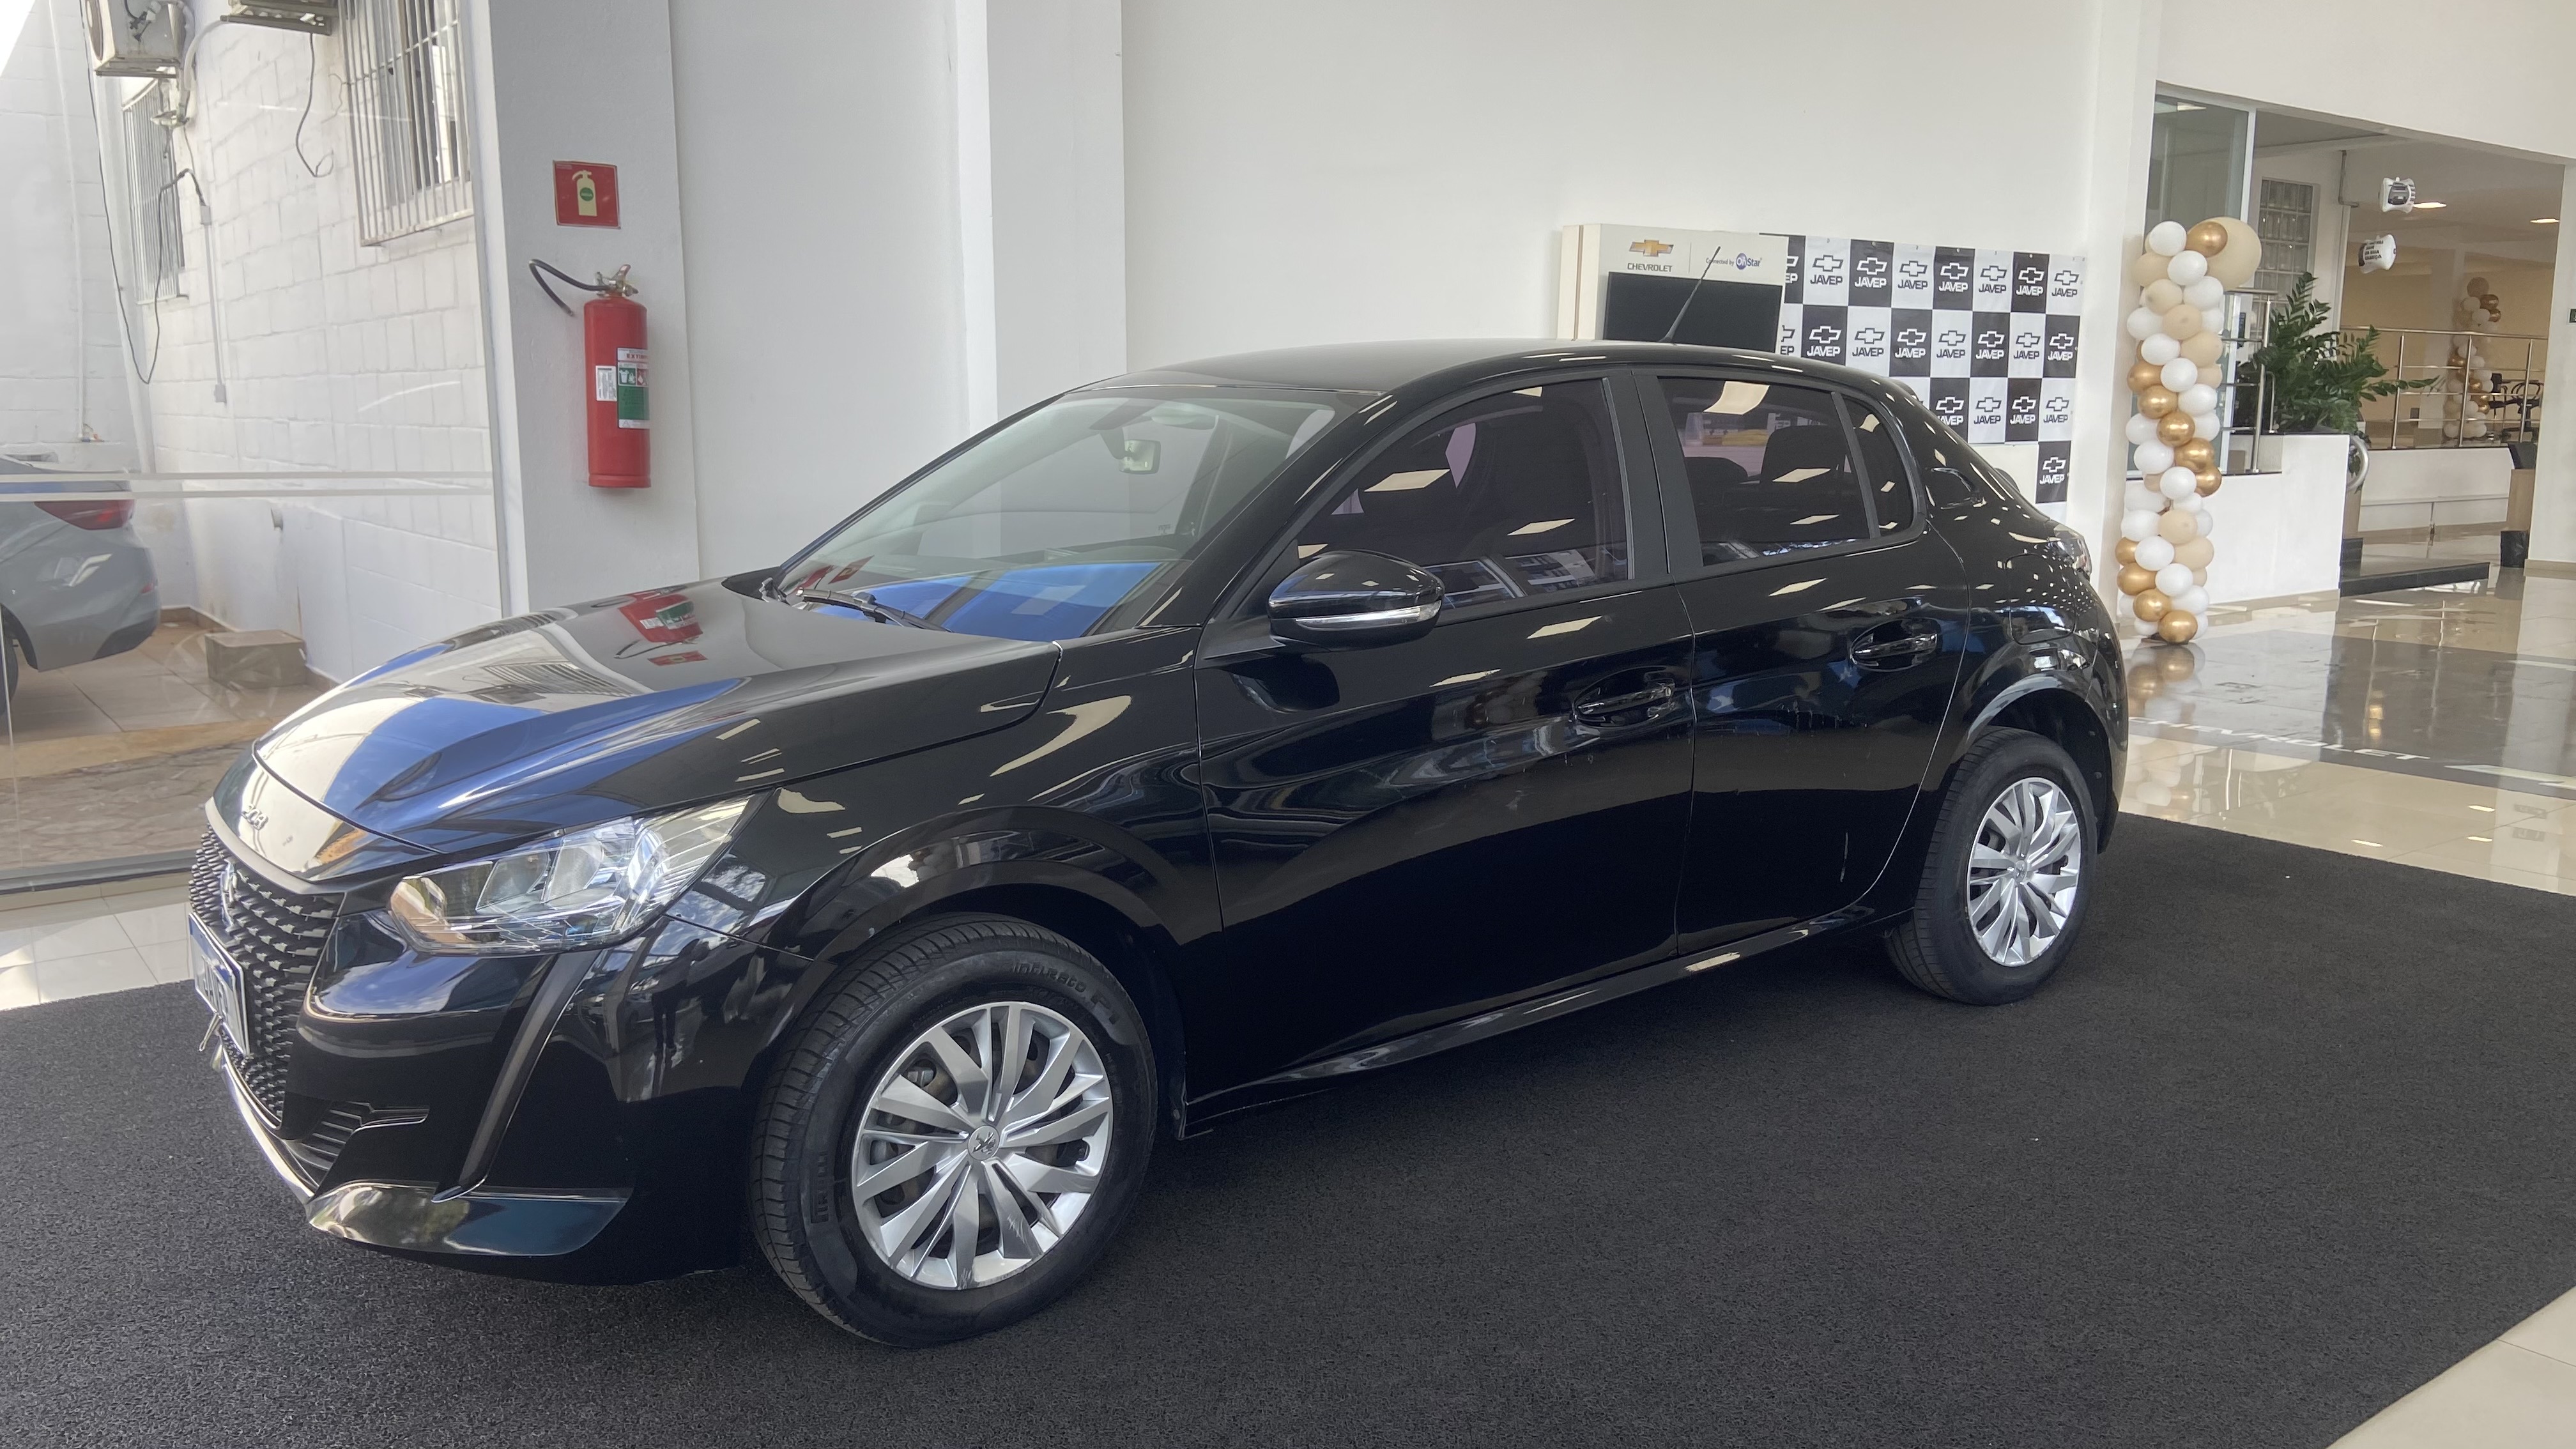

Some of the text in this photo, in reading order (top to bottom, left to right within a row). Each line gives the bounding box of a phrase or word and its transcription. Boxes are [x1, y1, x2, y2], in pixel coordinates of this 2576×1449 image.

[1627, 263, 1673, 273] CHEVROLET
[1810, 274, 1843, 286] JAVEP
[1854, 277, 1887, 288] JAVEP
[1897, 279, 1928, 289] JAVEP
[1938, 281, 1968, 293] JAVEP
[1979, 284, 2007, 294] JAVEP
[2016, 285, 2044, 296] JAVEP
[2051, 288, 2078, 298] JAVEP
[1806, 346, 1841, 357] JAVEP
[1851, 347, 1884, 357] JAVEP
[1894, 348, 1926, 358] JAVEP
[1936, 349, 1966, 358] JAVEP
[1975, 349, 2005, 360] JAVEP
[2013, 351, 2040, 360] JAVEP
[2047, 351, 2073, 362] JAVEP
[1938, 415, 1963, 426] AVEP
[1974, 415, 2001, 425] JAVEP
[2009, 414, 2036, 425] JAVEP
[2043, 415, 2068, 424] JAVEP
[2039, 474, 2065, 485] JAVEP
